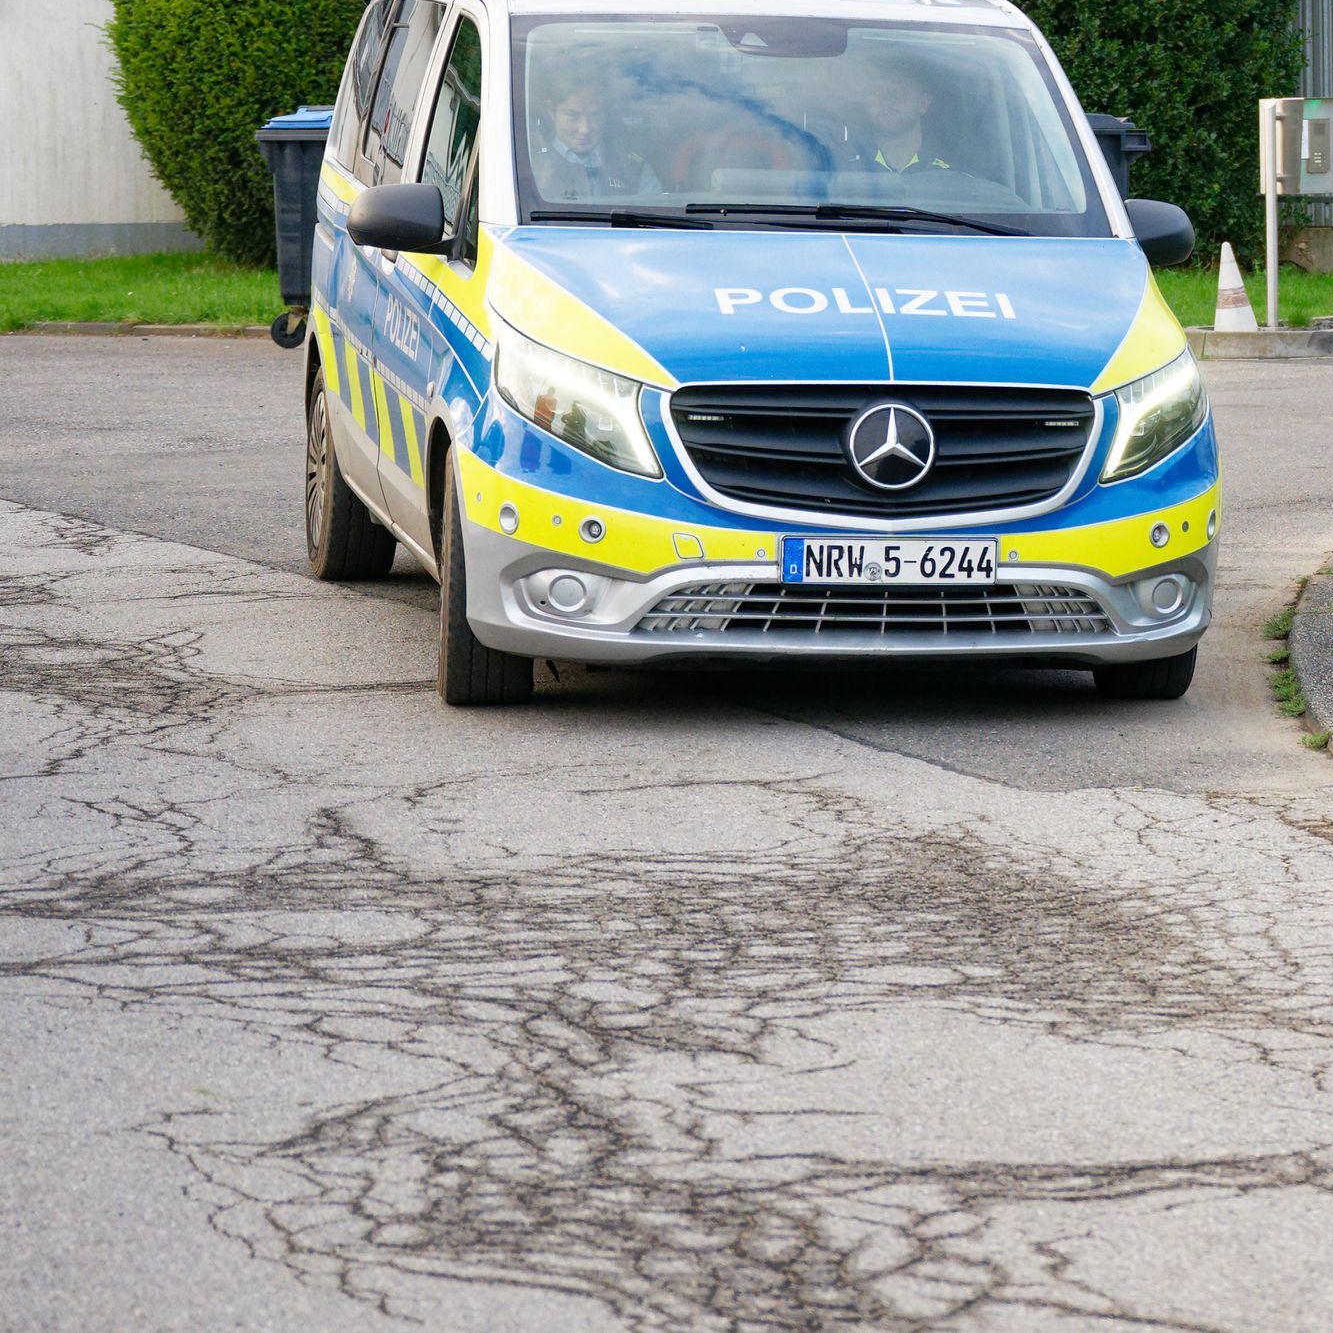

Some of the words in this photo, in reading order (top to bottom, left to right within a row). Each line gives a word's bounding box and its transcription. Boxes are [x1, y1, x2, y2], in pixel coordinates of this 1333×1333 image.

[713, 287, 1017, 319] POLIZEI
[384, 292, 420, 362] POLIZEI
[789, 564, 798, 574] D
[805, 544, 865, 578] NRW
[884, 545, 994, 579] 5-6244
